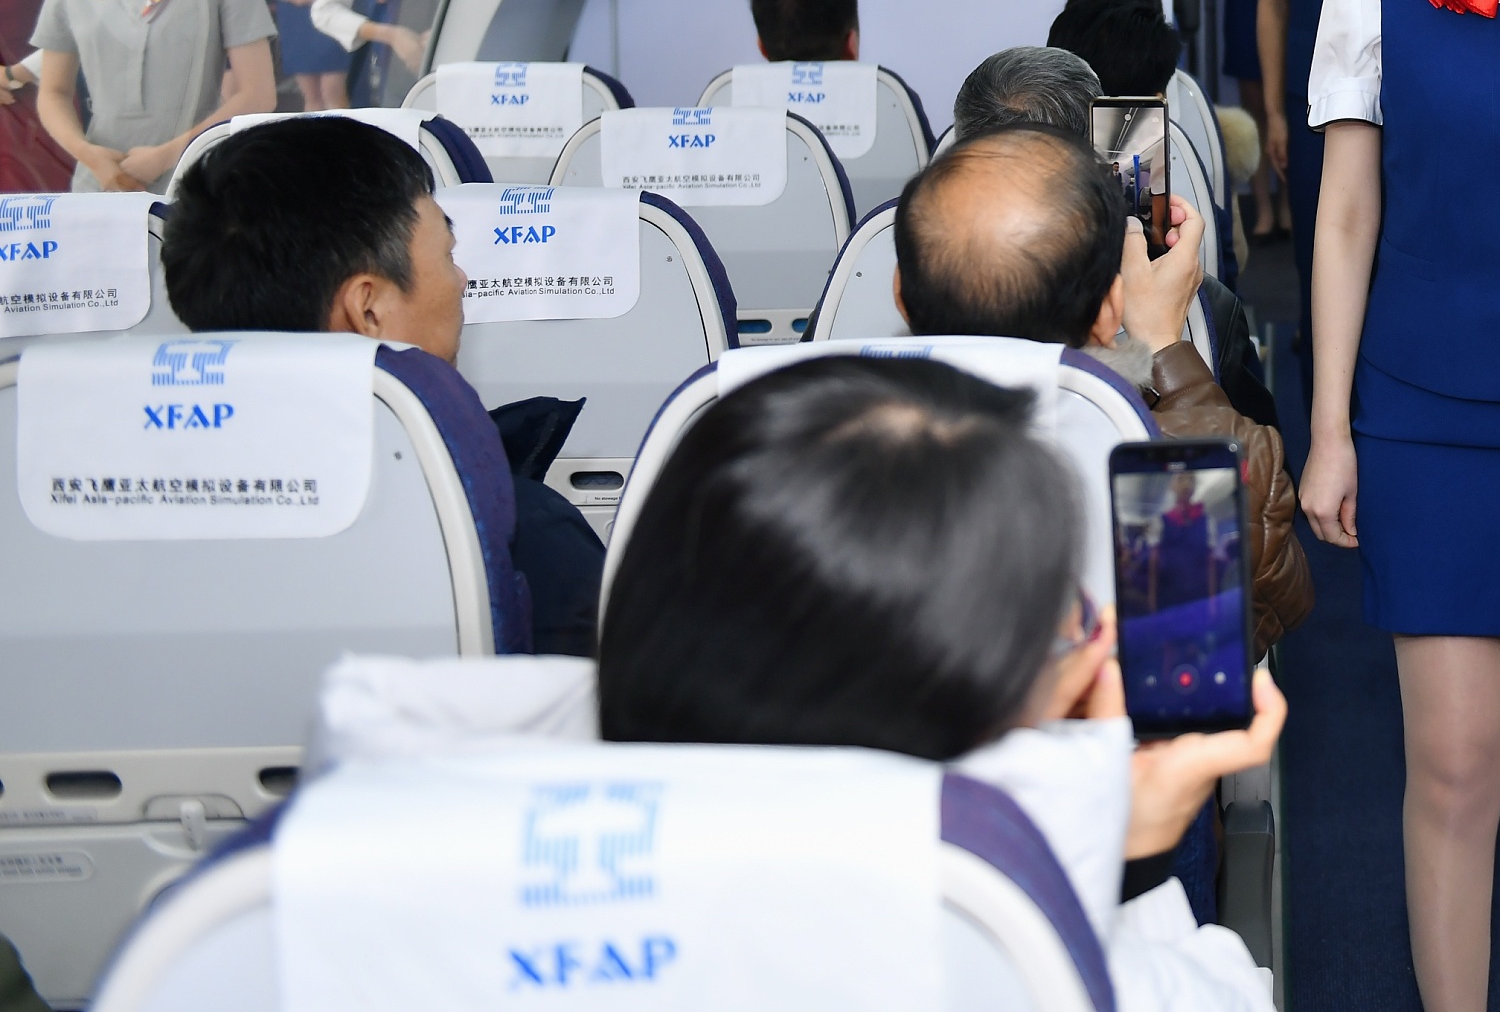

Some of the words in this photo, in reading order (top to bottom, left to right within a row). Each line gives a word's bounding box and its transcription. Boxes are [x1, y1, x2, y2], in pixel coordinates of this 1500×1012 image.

[491, 94, 530, 105] XFAP
[787, 92, 826, 103] XFAP
[668, 134, 716, 148] XFAP
[494, 225, 556, 245] XFAP
[507, 288, 538, 296] Aviation
[539, 287, 583, 296] Simulation
[4, 304, 41, 314] Aviation
[43, 301, 86, 311] Simulation
[143, 403, 236, 430] XFAP
[160, 495, 207, 505] Aviation
[210, 495, 273, 505] Simulation
[506, 935, 678, 989] XFAP
